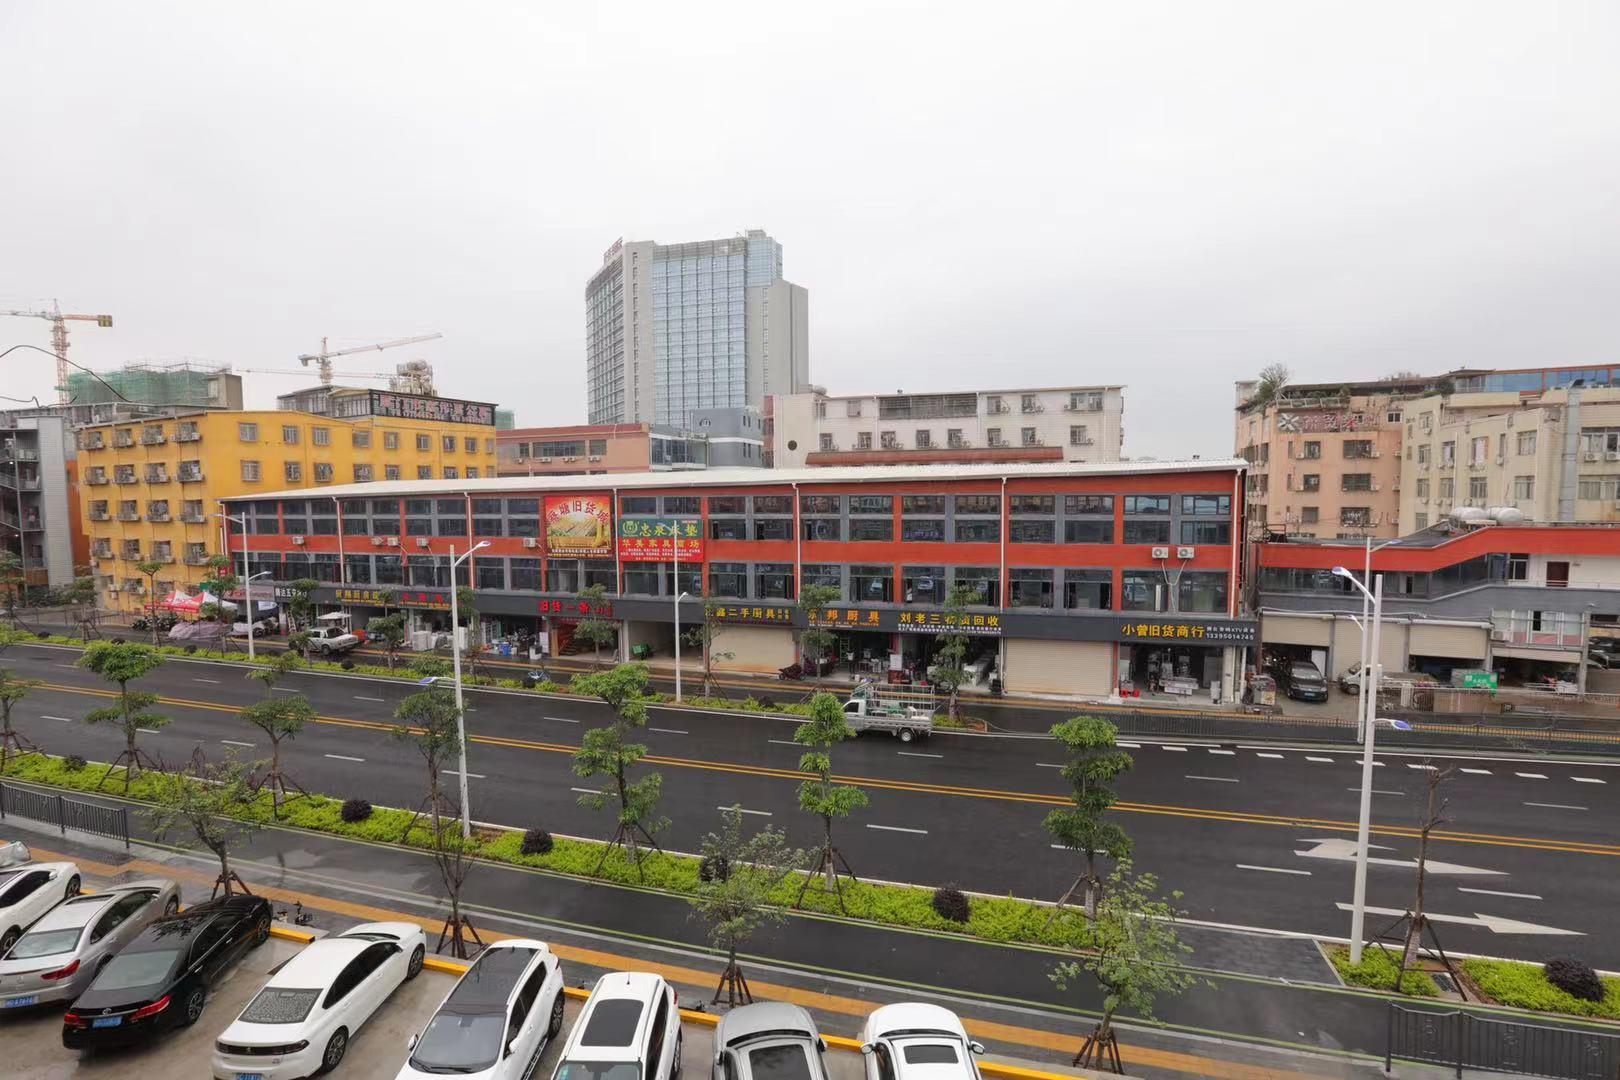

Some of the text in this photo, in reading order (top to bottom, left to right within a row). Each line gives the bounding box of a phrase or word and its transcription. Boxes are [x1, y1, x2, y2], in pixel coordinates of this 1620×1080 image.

[1121, 623, 1205, 638] 小曾旧货商行
